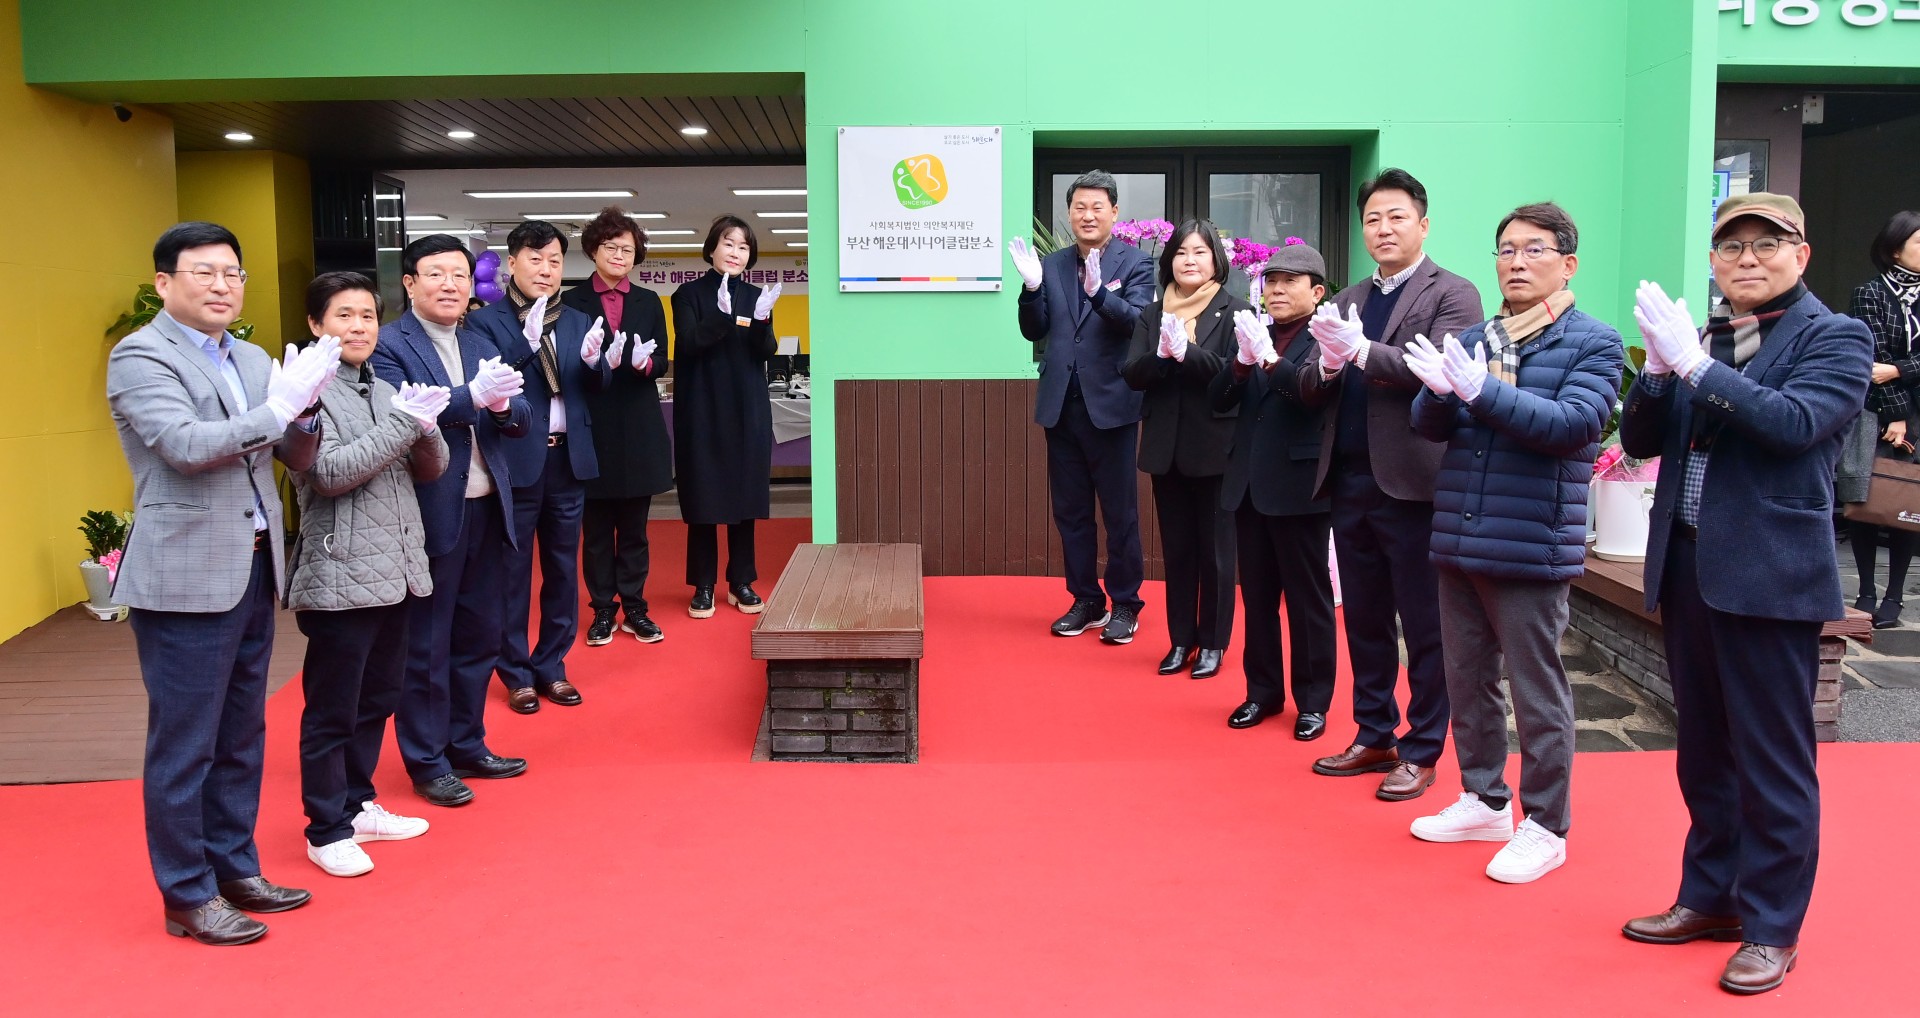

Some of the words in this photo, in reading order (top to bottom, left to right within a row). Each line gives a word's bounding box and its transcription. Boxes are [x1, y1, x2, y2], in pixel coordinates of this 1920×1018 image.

[869, 221, 920, 230] 사회복지법인
[924, 221, 974, 230] 의안복지재단
[846, 236, 870, 250] 부산
[640, 270, 666, 283] 부산
[783, 270, 808, 283] 분소
